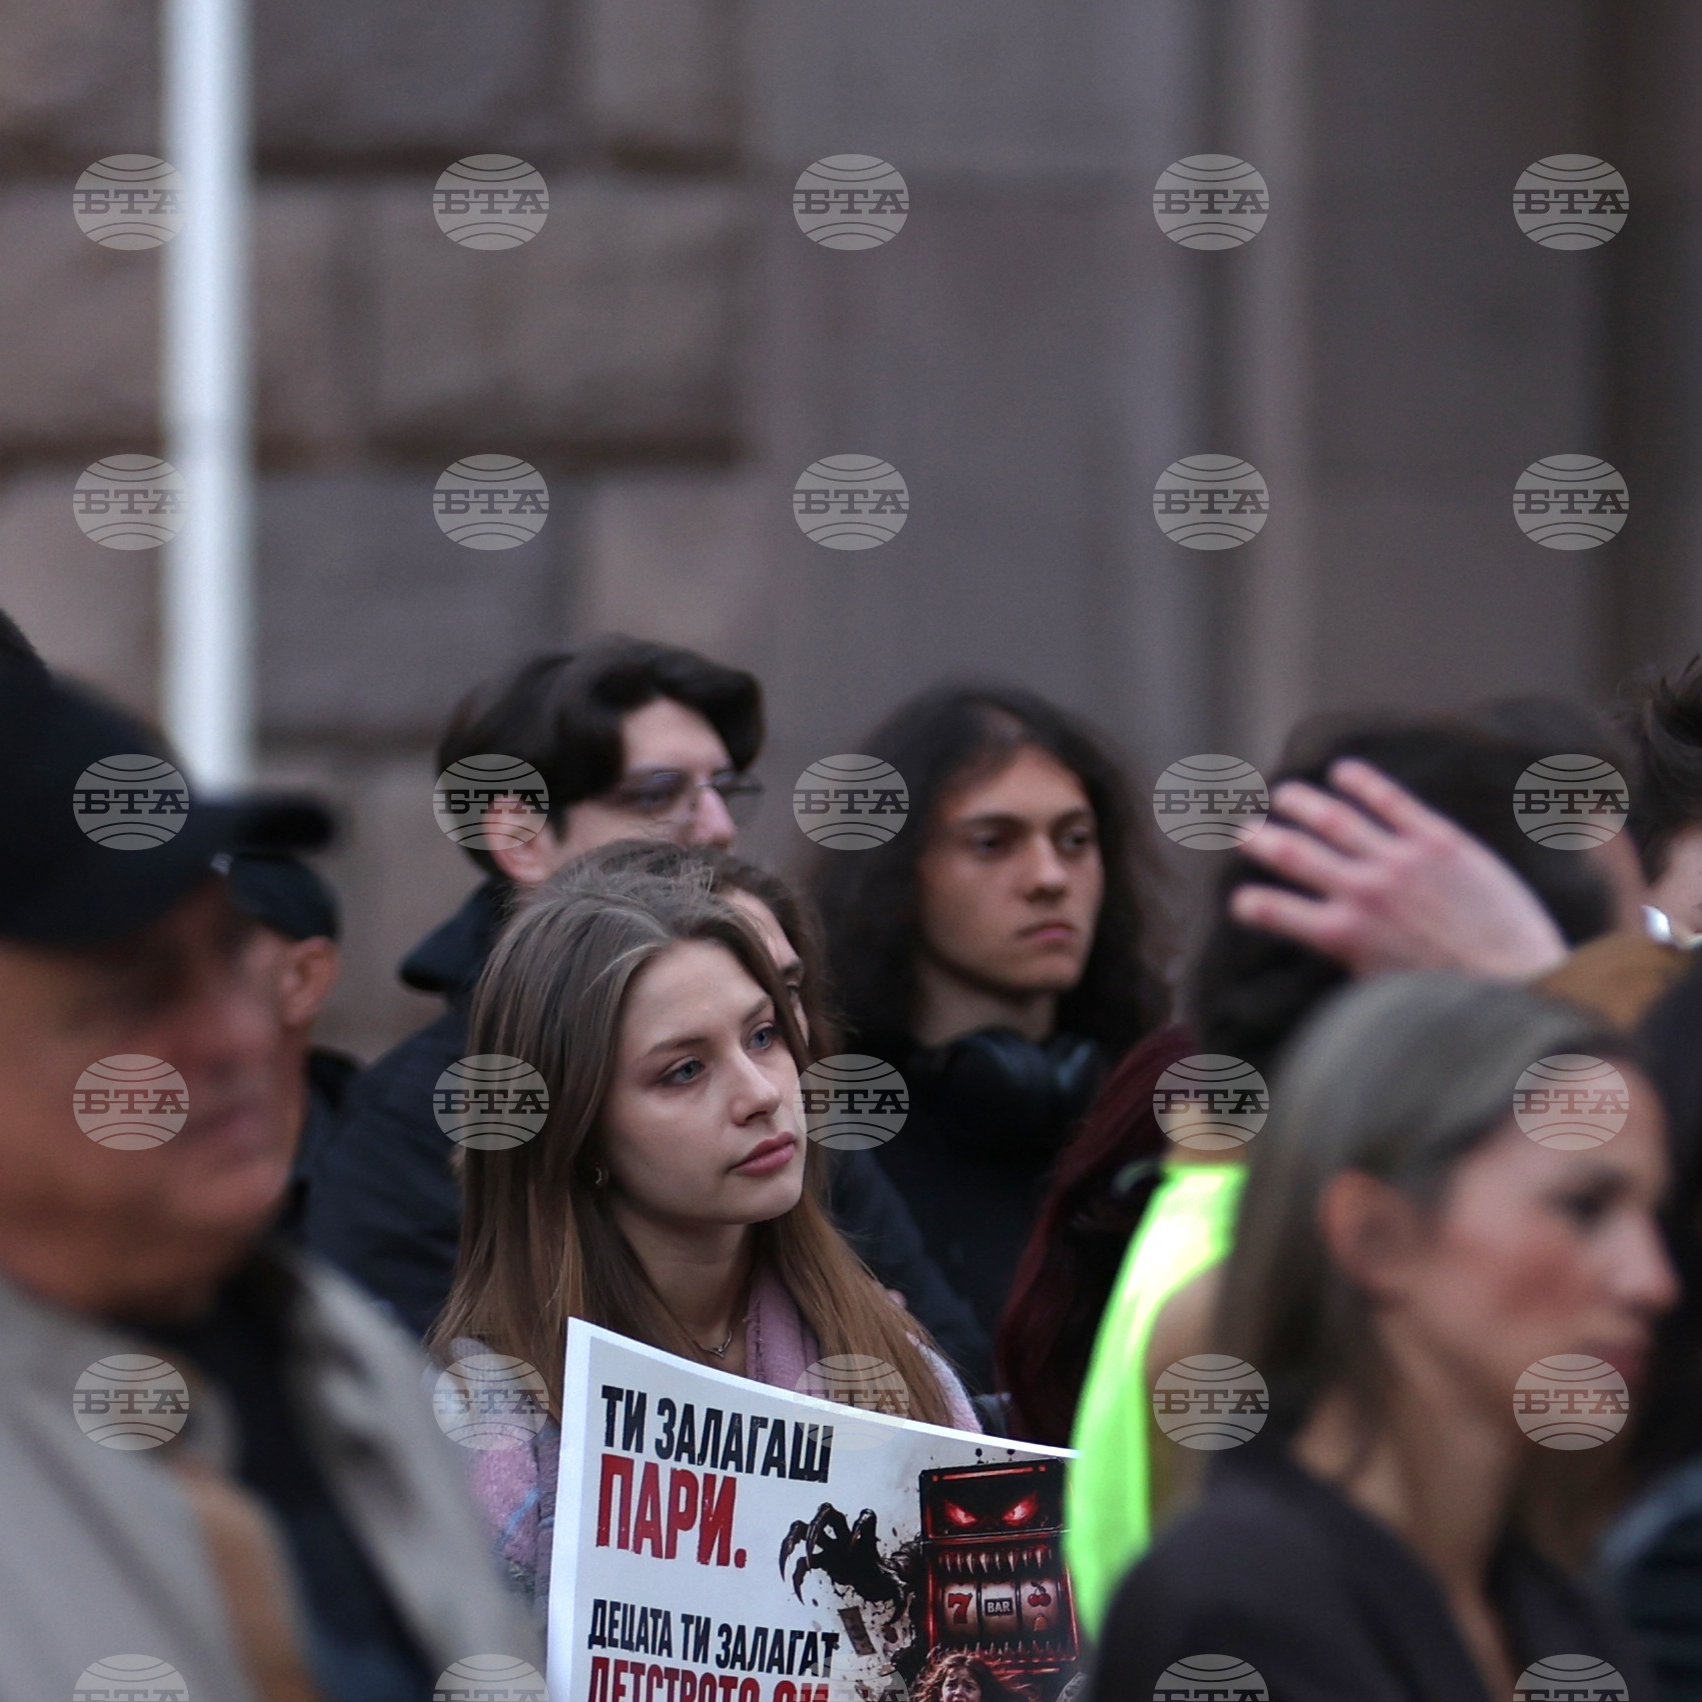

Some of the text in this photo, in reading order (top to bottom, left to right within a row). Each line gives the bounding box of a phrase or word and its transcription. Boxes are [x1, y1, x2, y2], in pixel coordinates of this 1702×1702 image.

[602, 1385, 834, 1484] ТИ ЗАЛАГАШ
[596, 1453, 747, 1568] ПАРИ.
[587, 1598, 840, 1678] ДЕЦАТА ТИ ЗАЛАГАТ
[948, 1592, 973, 1624] 7
[986, 1600, 1012, 1614] BAR
